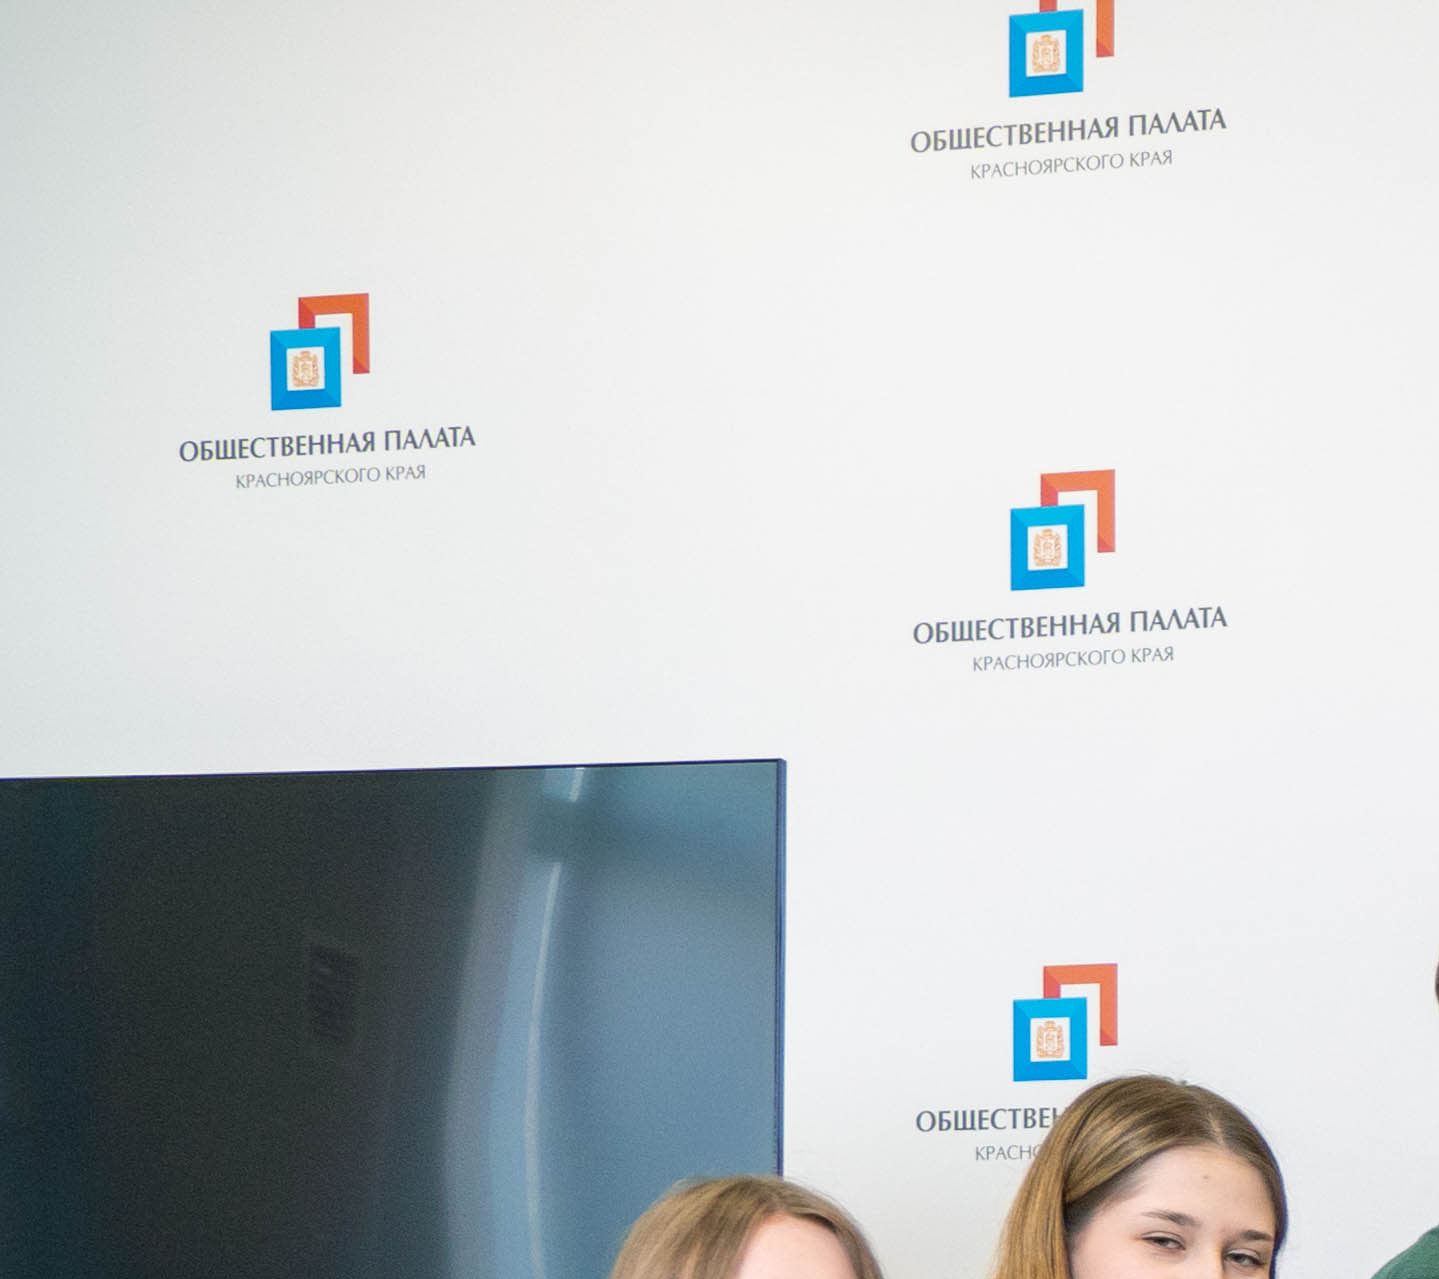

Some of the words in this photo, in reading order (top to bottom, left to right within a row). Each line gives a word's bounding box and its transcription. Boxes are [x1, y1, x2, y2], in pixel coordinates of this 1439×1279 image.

[910, 116, 1120, 153] ОБЩЕСТВЕННАЯ
[1129, 108, 1228, 137] ПАЛАТА
[971, 154, 1125, 180] КРАСНОЯРСКОГО
[1130, 149, 1173, 168] КРАЯ
[178, 431, 377, 462] ОБЩЕСТВЕННАЯ
[384, 425, 477, 452] ПАЛАТА
[235, 467, 382, 488] КРАСНОЯРСКОГО
[386, 464, 427, 481] КРАЯ
[912, 612, 1121, 644] ОБЩЕСТВЕННАЯ
[1130, 606, 1229, 633] ПАЛАТА
[973, 648, 1127, 672] КРАСНОЯРСКОГО
[1131, 646, 1174, 664] КРАЯ
[916, 1107, 1058, 1132] ОБЩЕСТВЕ
